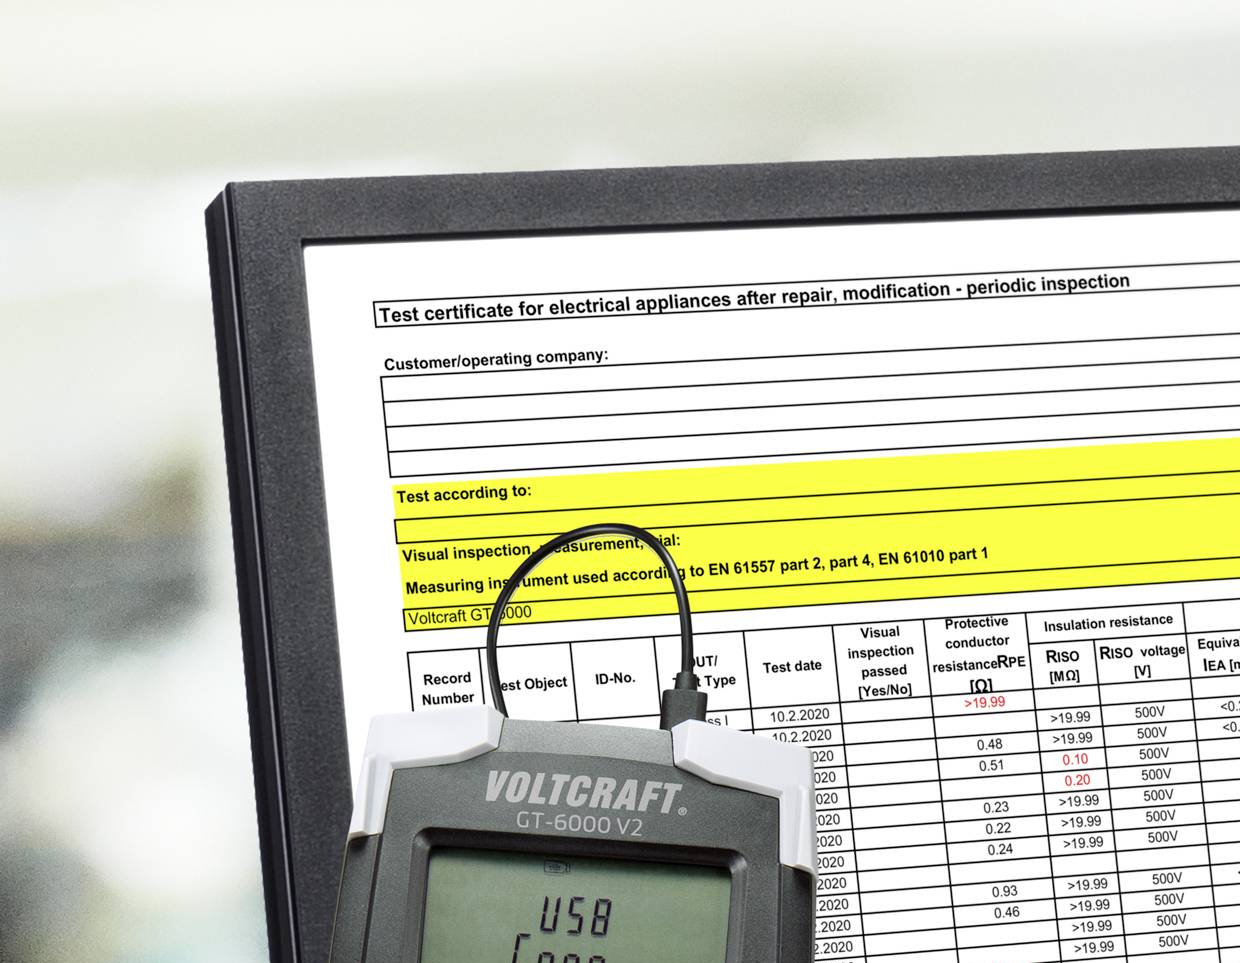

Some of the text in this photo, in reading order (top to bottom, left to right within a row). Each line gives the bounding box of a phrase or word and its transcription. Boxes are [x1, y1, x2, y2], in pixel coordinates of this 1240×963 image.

[379, 307, 419, 322] Test
[425, 304, 513, 320] certificate
[519, 301, 544, 316] for
[550, 297, 630, 314] electrical
[636, 294, 731, 312] appliances
[737, 291, 776, 305] after
[782, 287, 838, 307] repair,
[843, 283, 950, 300] modification
[967, 278, 1036, 300] periodic
[1042, 274, 1129, 294] inspection
[385, 351, 608, 370] Customer/operating company:
[397, 485, 531, 503] Test according to:
[402, 548, 448, 562] Visual
[406, 579, 483, 594] Measuring
[573, 570, 608, 584] used
[690, 566, 704, 577] to
[709, 563, 729, 575] EN
[734, 560, 775, 574] 61557
[781, 559, 809, 574] part
[813, 557, 825, 570] 2,
[830, 556, 858, 571] part
[862, 554, 874, 567] 4,
[879, 552, 898, 565] EN
[904, 550, 944, 563] 61010
[950, 548, 977, 564] part
[982, 547, 987, 558] 1
[408, 609, 466, 624] Voltcraft
[945, 616, 1009, 630] Protective
[1045, 616, 1173, 632] Insulation resistance
[860, 626, 899, 638] Visual
[946, 636, 1009, 649] conductor
[848, 646, 914, 660] inspection
[1046, 650, 1079, 663] RISO
[1100, 645, 1185, 659] RISO voltage
[693, 655, 718, 668] UT/
[763, 661, 822, 673] Test date
[424, 672, 471, 685] Record
[596, 672, 635, 684] ID-No.
[862, 664, 907, 680] passed
[1134, 665, 1151, 679] [V]
[501, 677, 567, 692] est Object
[704, 675, 735, 688] Type
[970, 679, 994, 693] [Ω]
[422, 693, 474, 701] Number
[858, 683, 912, 699] [Yes/No]
[965, 696, 1006, 709] >19.99
[770, 707, 830, 723] 10.2.2020
[1051, 711, 1090, 723] >19.99
[1136, 706, 1164, 718] 500V
[977, 738, 1002, 750] 0.48
[980, 760, 1003, 771] 0.51
[1063, 753, 1088, 765] 0.10
[1065, 774, 1090, 786] 0.20
[516, 811, 643, 836] GT-6000 V2
[992, 885, 1017, 897] 0.93
[540, 896, 612, 936] USB
